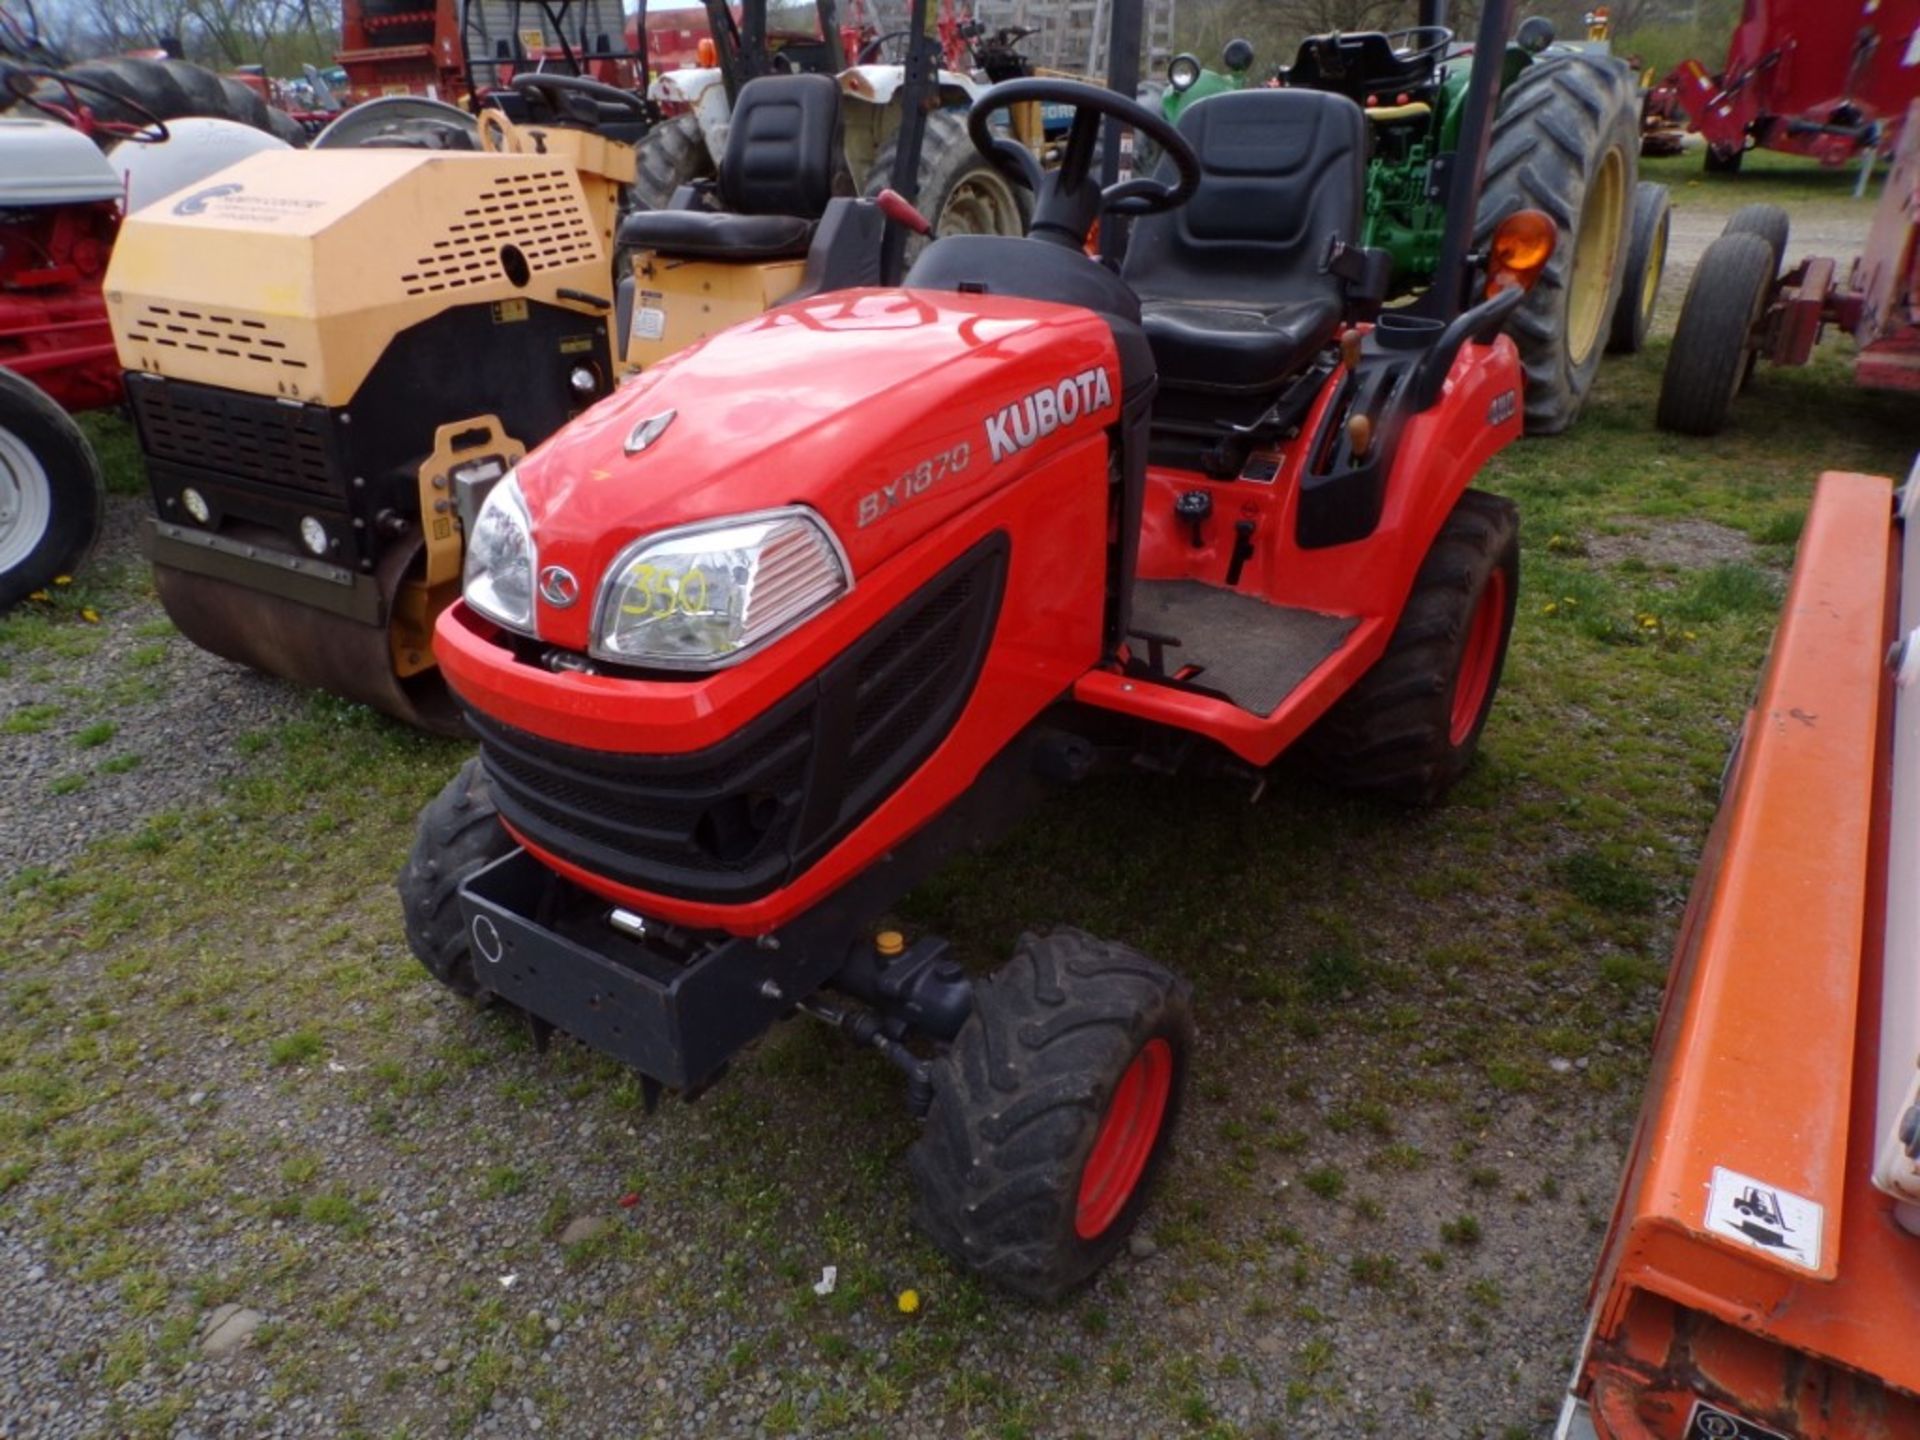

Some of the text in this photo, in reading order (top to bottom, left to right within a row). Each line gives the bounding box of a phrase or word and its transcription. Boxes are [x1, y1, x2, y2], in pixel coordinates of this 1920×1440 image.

[984, 366, 1111, 464] KUBOTA
[857, 441, 971, 527] BX1870
[622, 563, 707, 620] 350
